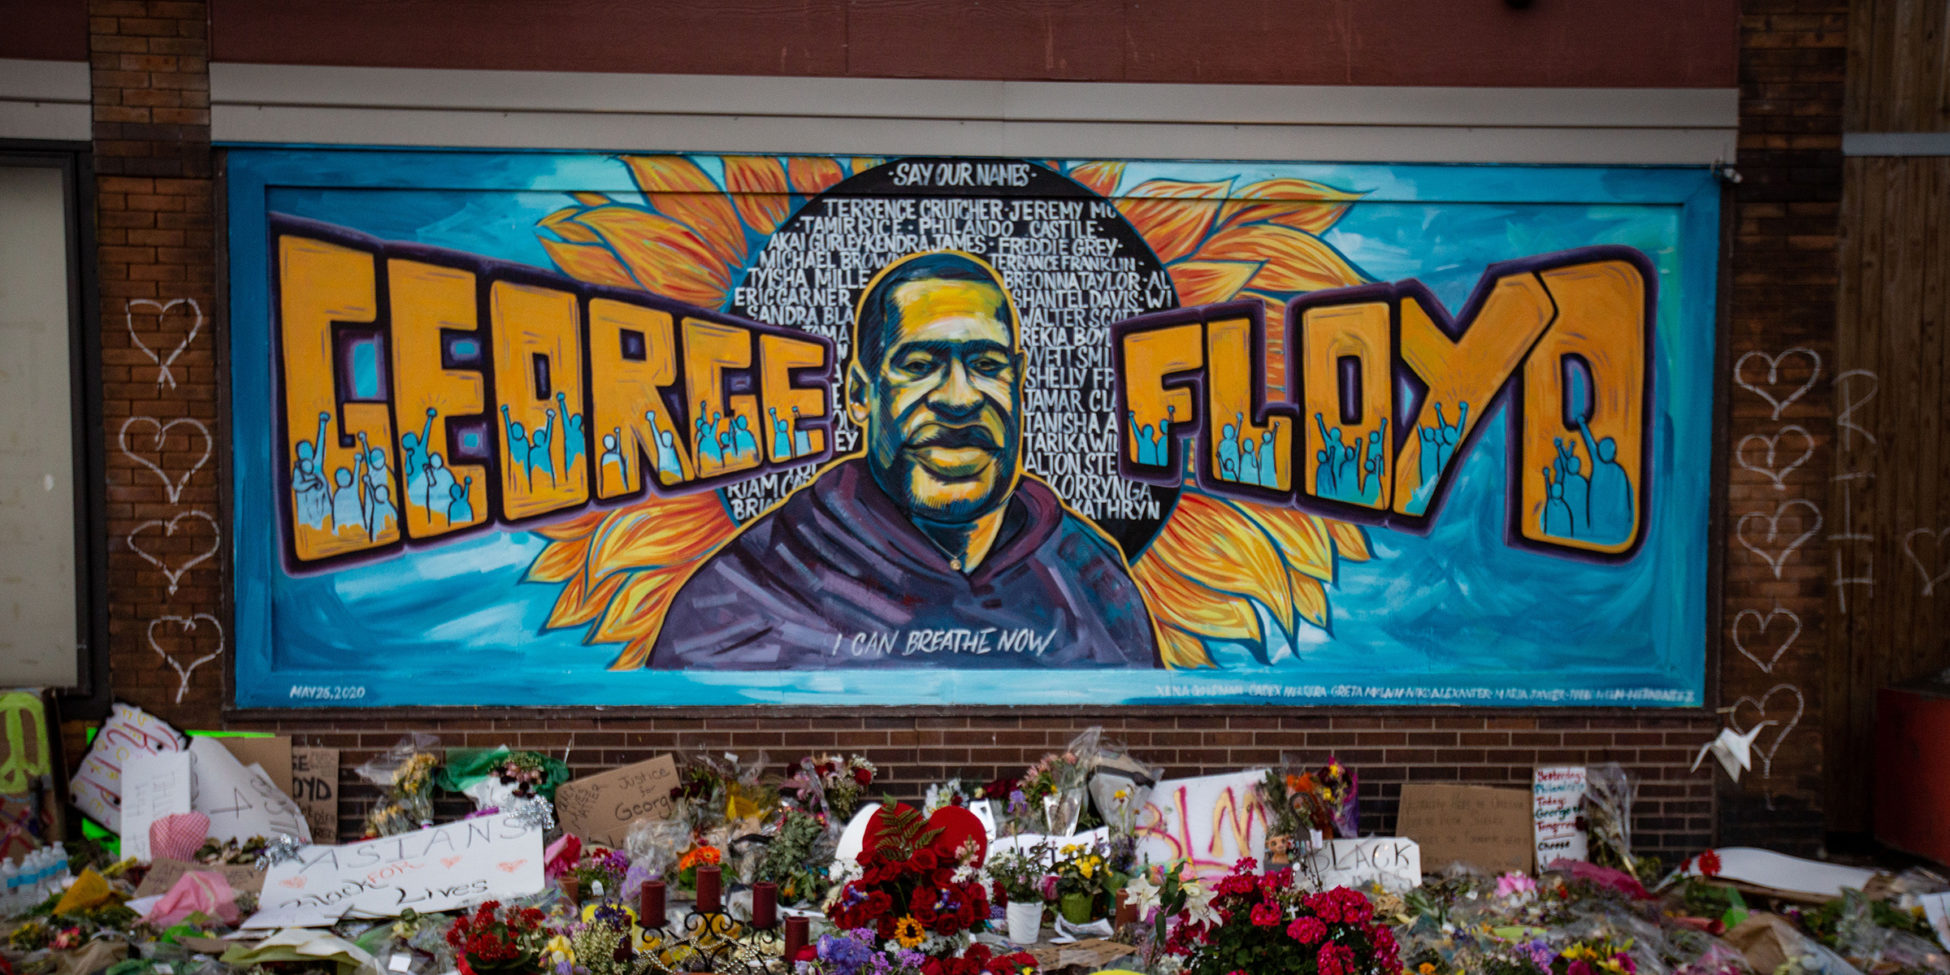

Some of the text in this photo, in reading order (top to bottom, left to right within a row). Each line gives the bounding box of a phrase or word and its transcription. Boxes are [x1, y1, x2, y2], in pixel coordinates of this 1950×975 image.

[893, 163, 1030, 187] SAY OUR NAMES
[823, 198, 917, 219] TERRENCE
[920, 200, 1003, 220] CRUTCHER
[1009, 202, 1084, 221] JEREMY
[801, 216, 1098, 239] TAMIR RICE PHILANDO CASTILE
[768, 231, 1119, 258] AKAI GURLEY KENDRA JAMES FREDDIE GREY
[759, 250, 836, 270] MICHAEL
[990, 253, 1136, 272] TERRANCE FRANKLIN
[746, 268, 809, 291] TYISHA
[1003, 271, 1171, 291] BREONNA TAYLOR AL
[734, 287, 854, 308] ERIC GARNER
[1013, 290, 1172, 310] SHANTEL DAVIS WI
[747, 305, 855, 326] SANDRA BLA
[1019, 308, 1088, 328] WALTER
[1020, 326, 1069, 347] REKIA
[1025, 346, 1075, 368] YVETT
[1025, 366, 1088, 389] SHELLY
[273, 229, 830, 565] GEORGE
[1022, 388, 1084, 413] JAMAR
[1116, 252, 1650, 558] FLOYD
[1023, 412, 1101, 434] TANISHA
[1023, 432, 1090, 454] TARIKA
[1024, 452, 1081, 476] ALTON
[831, 626, 1058, 657] I CAN BREATHE NOW
[289, 684, 316, 699] MAY
[618, 766, 671, 791] Justice
[1133, 784, 1268, 873] BLM
[299, 817, 529, 874] ASIANS
[1308, 839, 1412, 872] BLACK
[366, 861, 425, 887] FOR
